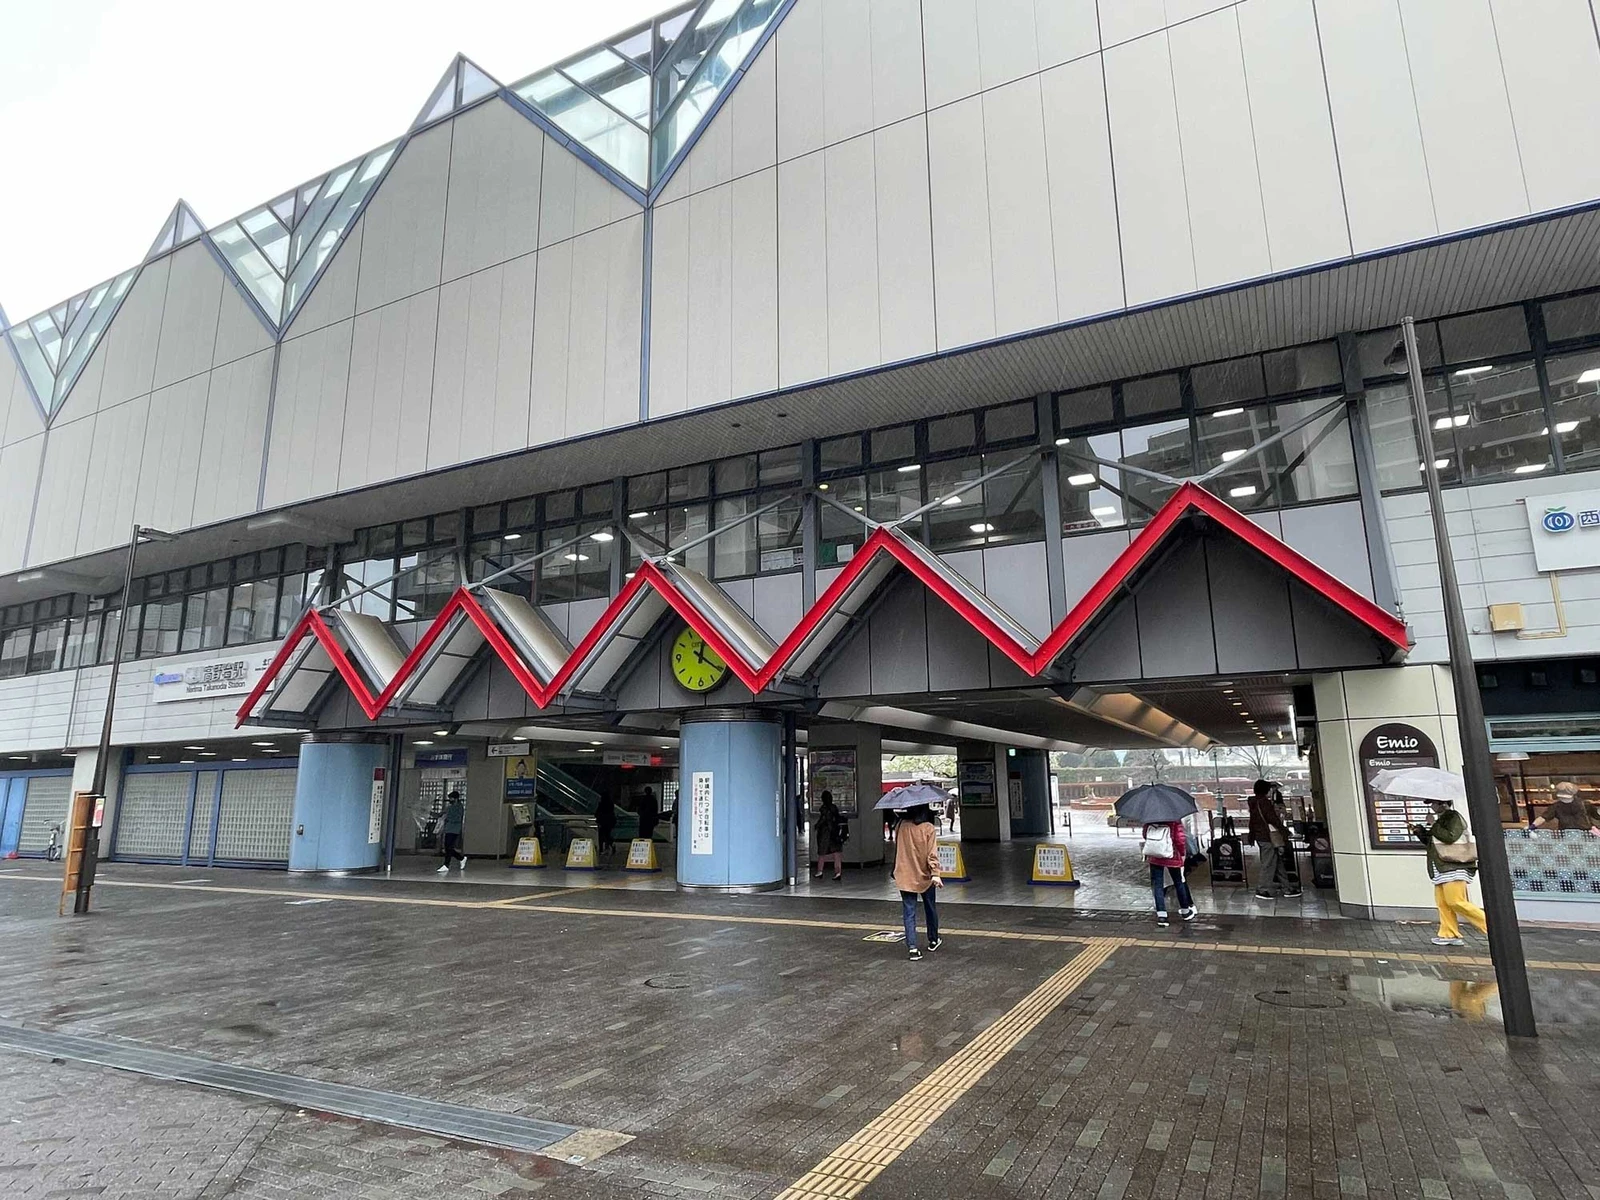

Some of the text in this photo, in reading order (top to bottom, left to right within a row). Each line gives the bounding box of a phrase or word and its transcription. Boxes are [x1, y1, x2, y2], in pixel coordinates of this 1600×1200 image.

[1580, 510, 1600, 526] 西
[675, 653, 682, 663] 9
[697, 676, 704, 687] 6
[1376, 735, 1419, 749] Emio
